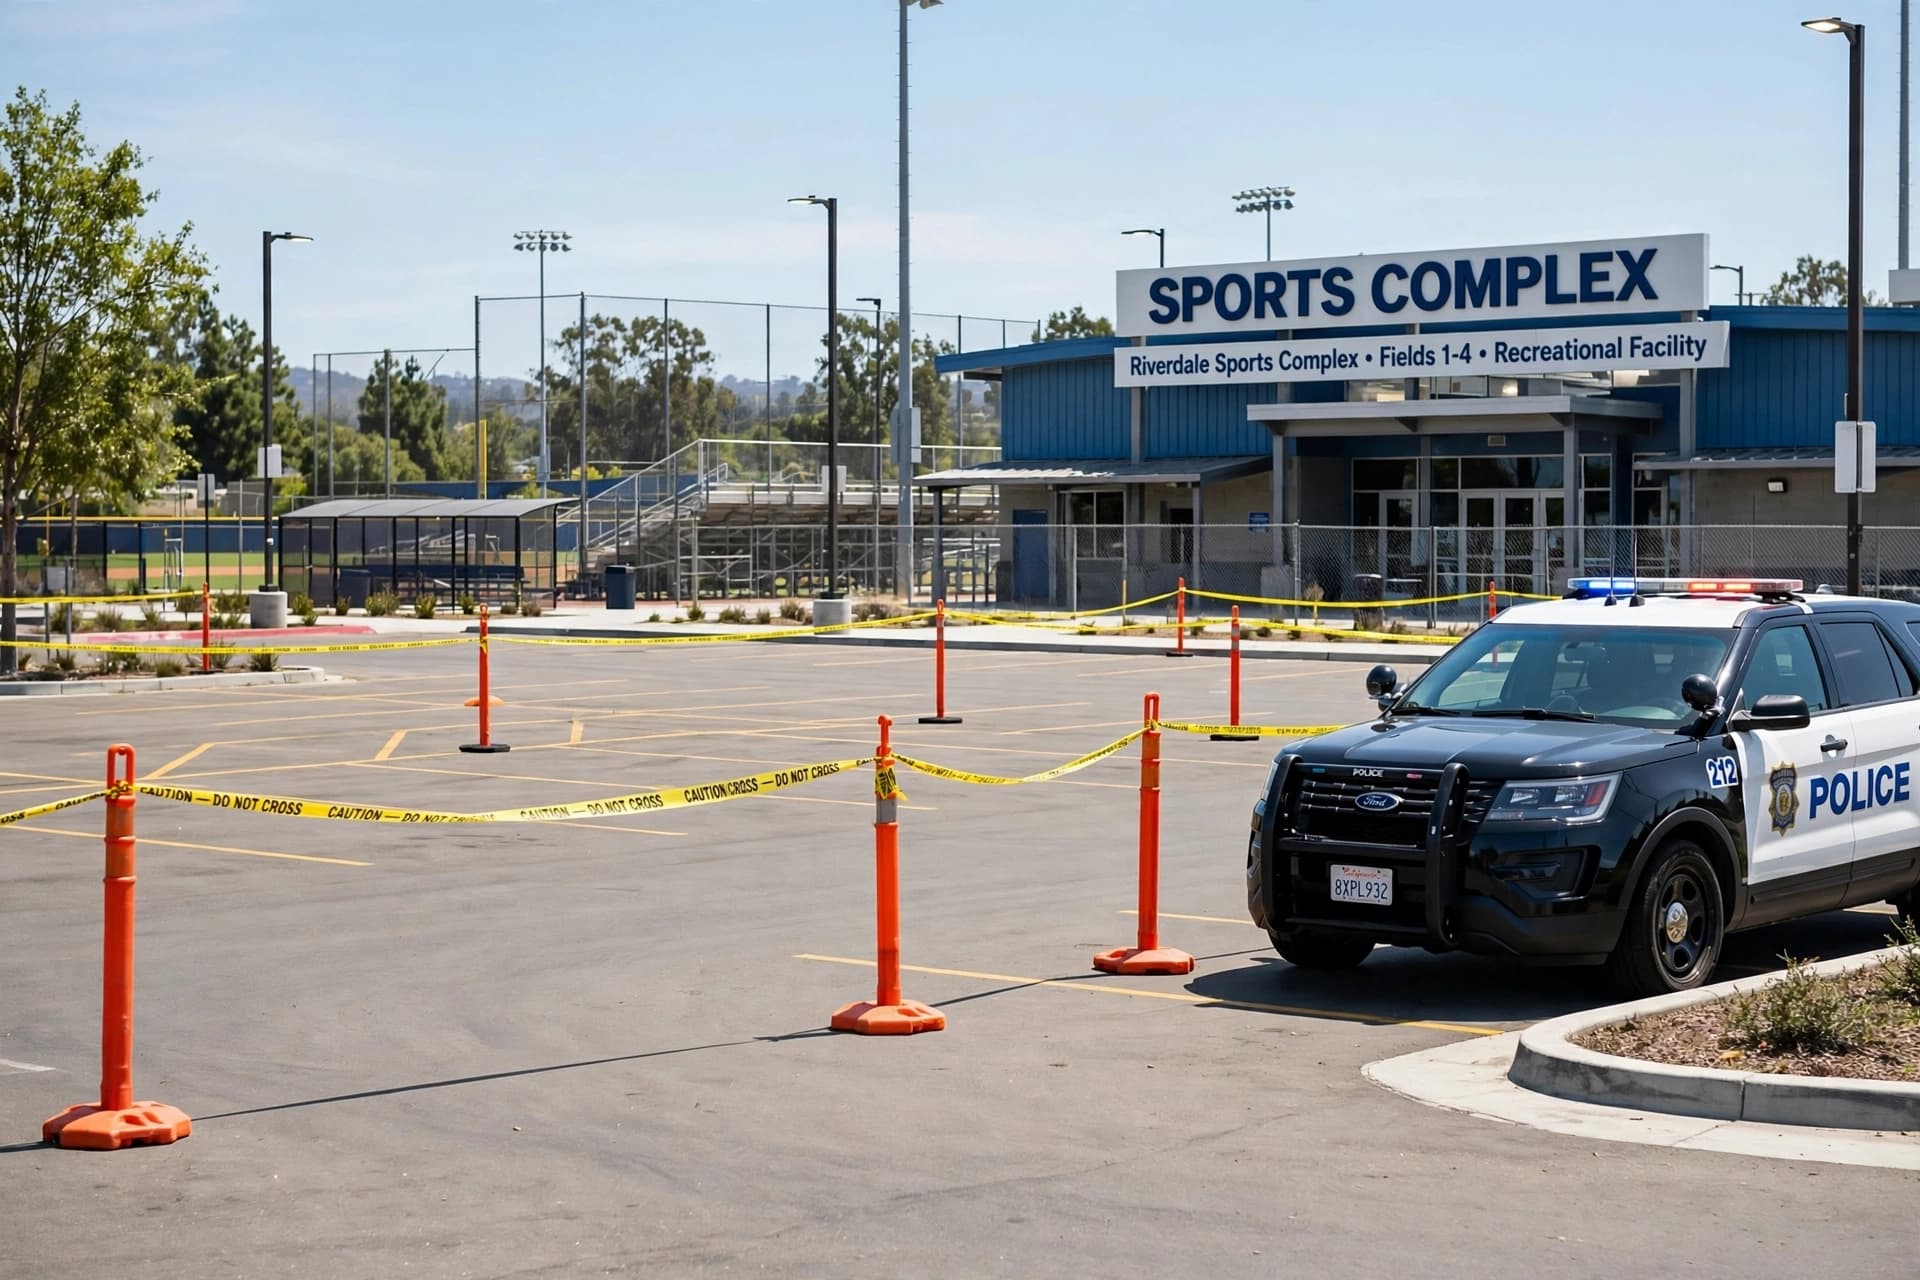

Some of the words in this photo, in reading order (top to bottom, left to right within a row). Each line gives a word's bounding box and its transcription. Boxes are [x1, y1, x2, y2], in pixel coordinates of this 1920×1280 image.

[1148, 266, 1356, 325] SPORTS
[1370, 247, 1659, 314] COMPLEX
[1130, 353, 1210, 376] Riverdale
[1214, 352, 1274, 378] Sports
[1278, 347, 1359, 375] Complex
[1379, 344, 1436, 368] Fields
[1441, 342, 1473, 366] 1-4
[1494, 336, 1623, 364] Recreational
[1629, 334, 1707, 362] Facility
[684, 780, 727, 803] CAUTION
[775, 773, 789, 787] DO
[791, 769, 809, 783] NOT
[811, 762, 841, 779] CROSS
[1352, 768, 1384, 778] POLICE
[1707, 757, 1738, 786] 212
[139, 786, 193, 803] CAUTION
[212, 794, 230, 807] DO
[233, 796, 259, 811] NOT
[261, 799, 303, 816] CROSS
[1809, 762, 1910, 820] POLICE
[327, 806, 383, 821] CAUTION
[401, 812, 421, 823] DO
[421, 814, 447, 824] NOT
[520, 806, 570, 820] CAUTION
[586, 803, 604, 816] DO
[605, 799, 627, 813] NOT
[629, 794, 664, 812] CROSS
[1335, 878, 1388, 900] 8XPL932
